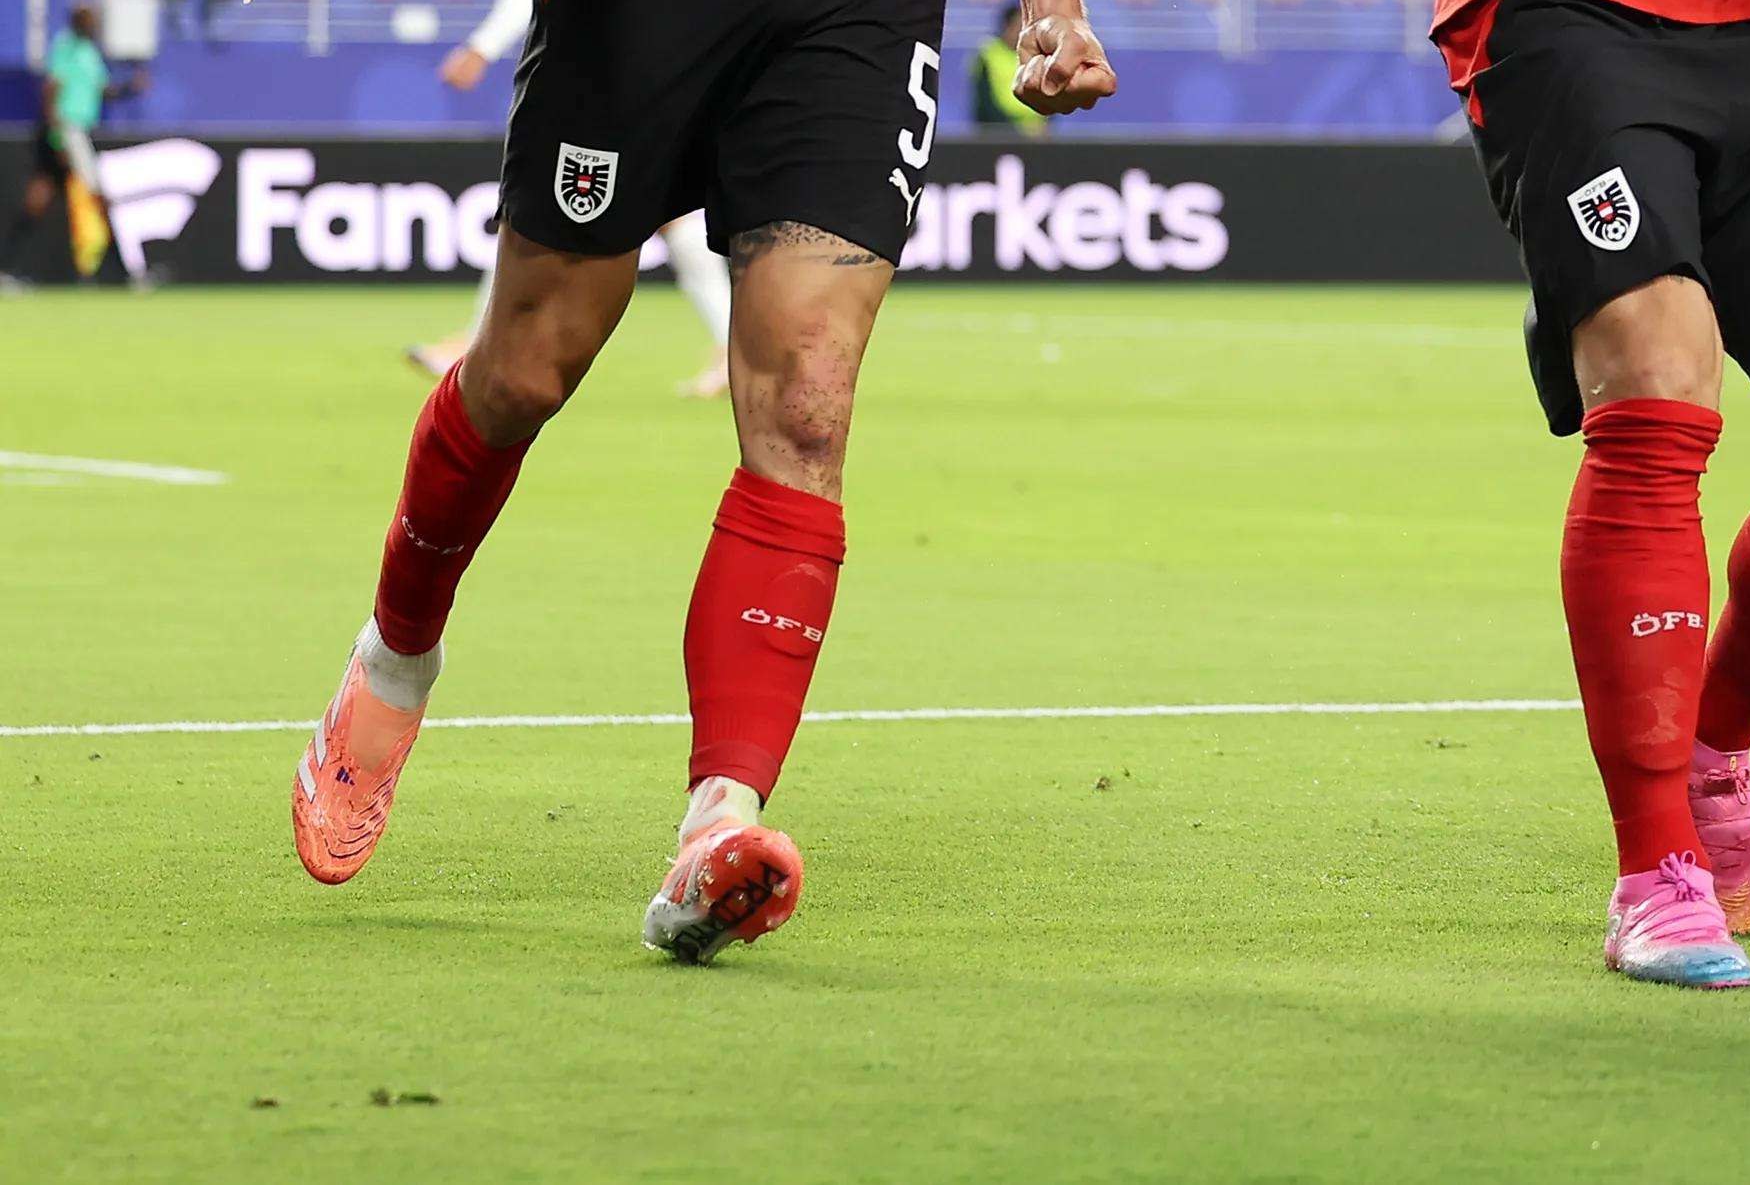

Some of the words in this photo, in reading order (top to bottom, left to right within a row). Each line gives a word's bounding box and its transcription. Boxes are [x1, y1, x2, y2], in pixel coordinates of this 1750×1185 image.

[898, 41, 941, 170] 5
[741, 606, 824, 643] ÖFB
[1630, 611, 1705, 637] ÖFB
